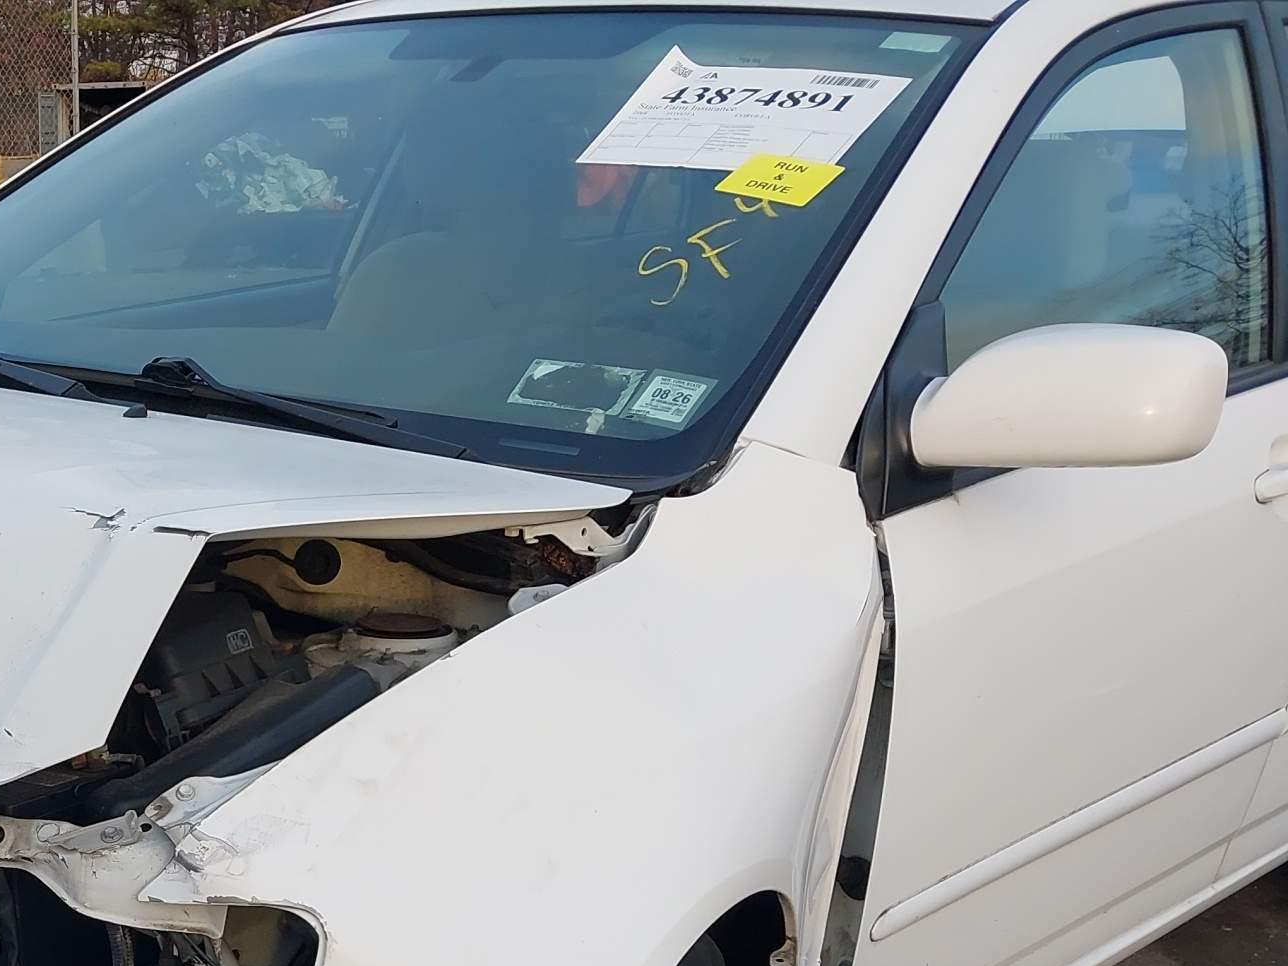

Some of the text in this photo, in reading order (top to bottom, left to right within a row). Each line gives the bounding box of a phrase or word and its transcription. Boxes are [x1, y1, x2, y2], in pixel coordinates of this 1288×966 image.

[662, 86, 855, 112] 43874891
[638, 103, 662, 111] State
[691, 105, 737, 113] Insurance
[774, 161, 809, 173] RUN
[773, 173, 785, 181] &
[745, 179, 792, 194] DRIVE
[652, 387, 671, 399] 08
[672, 391, 693, 404] 26
